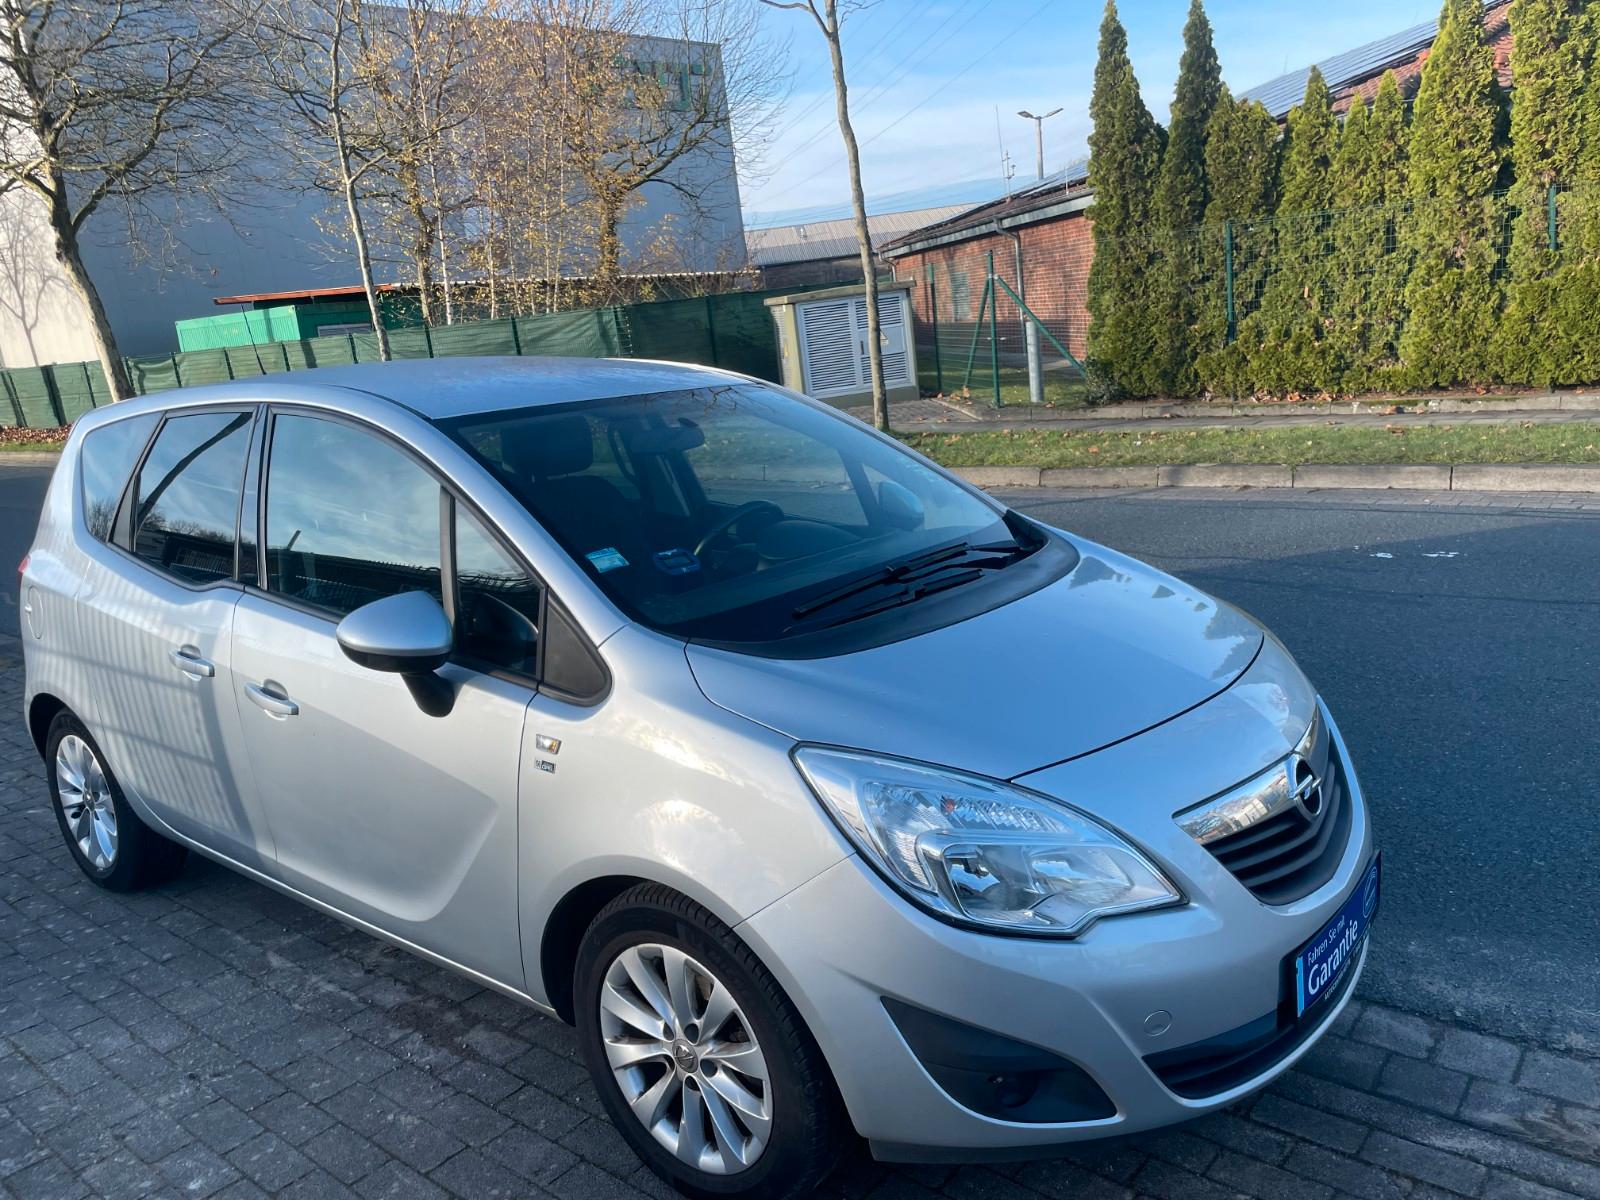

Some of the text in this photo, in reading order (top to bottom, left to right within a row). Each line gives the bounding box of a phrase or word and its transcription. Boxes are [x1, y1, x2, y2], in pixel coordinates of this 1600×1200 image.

[1308, 939, 1328, 967] Fahren
[1328, 928, 1337, 944] Sie
[1308, 919, 1358, 995] Garantie
